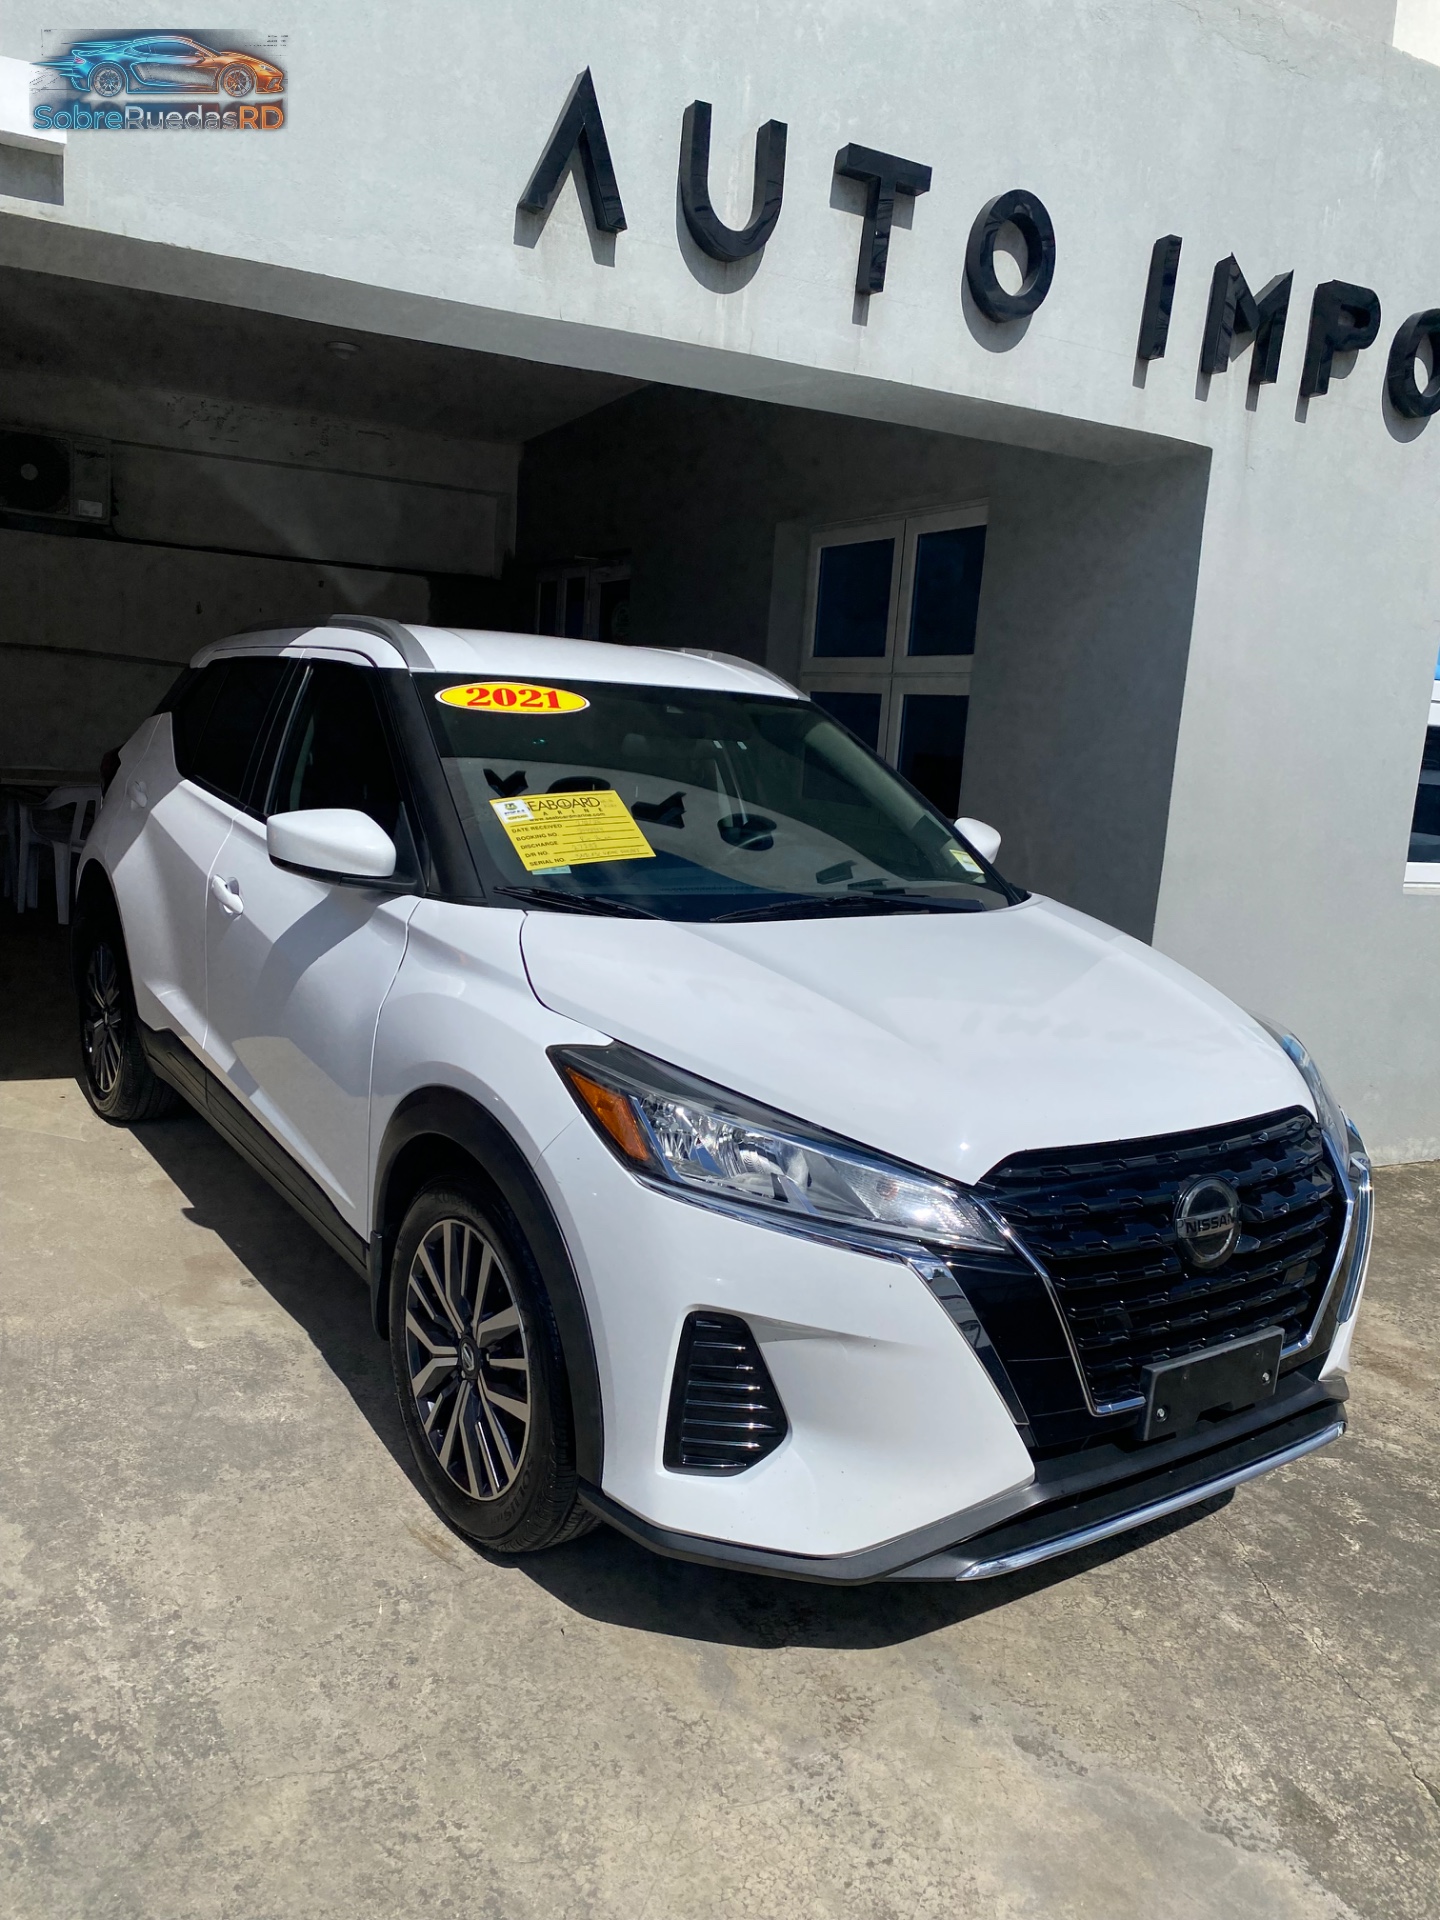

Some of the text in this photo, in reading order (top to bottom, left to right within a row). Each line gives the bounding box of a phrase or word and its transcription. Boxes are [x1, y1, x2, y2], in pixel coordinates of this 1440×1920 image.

[517, 66, 1440, 417] AUTO IMPO
[465, 687, 562, 709] 2021
[525, 797, 600, 812] EABOARD
[515, 833, 547, 842] BOOKING
[520, 841, 559, 850] DISCHARGE
[529, 858, 554, 867] SERIAL
[1185, 1214, 1236, 1235] NISSAN
